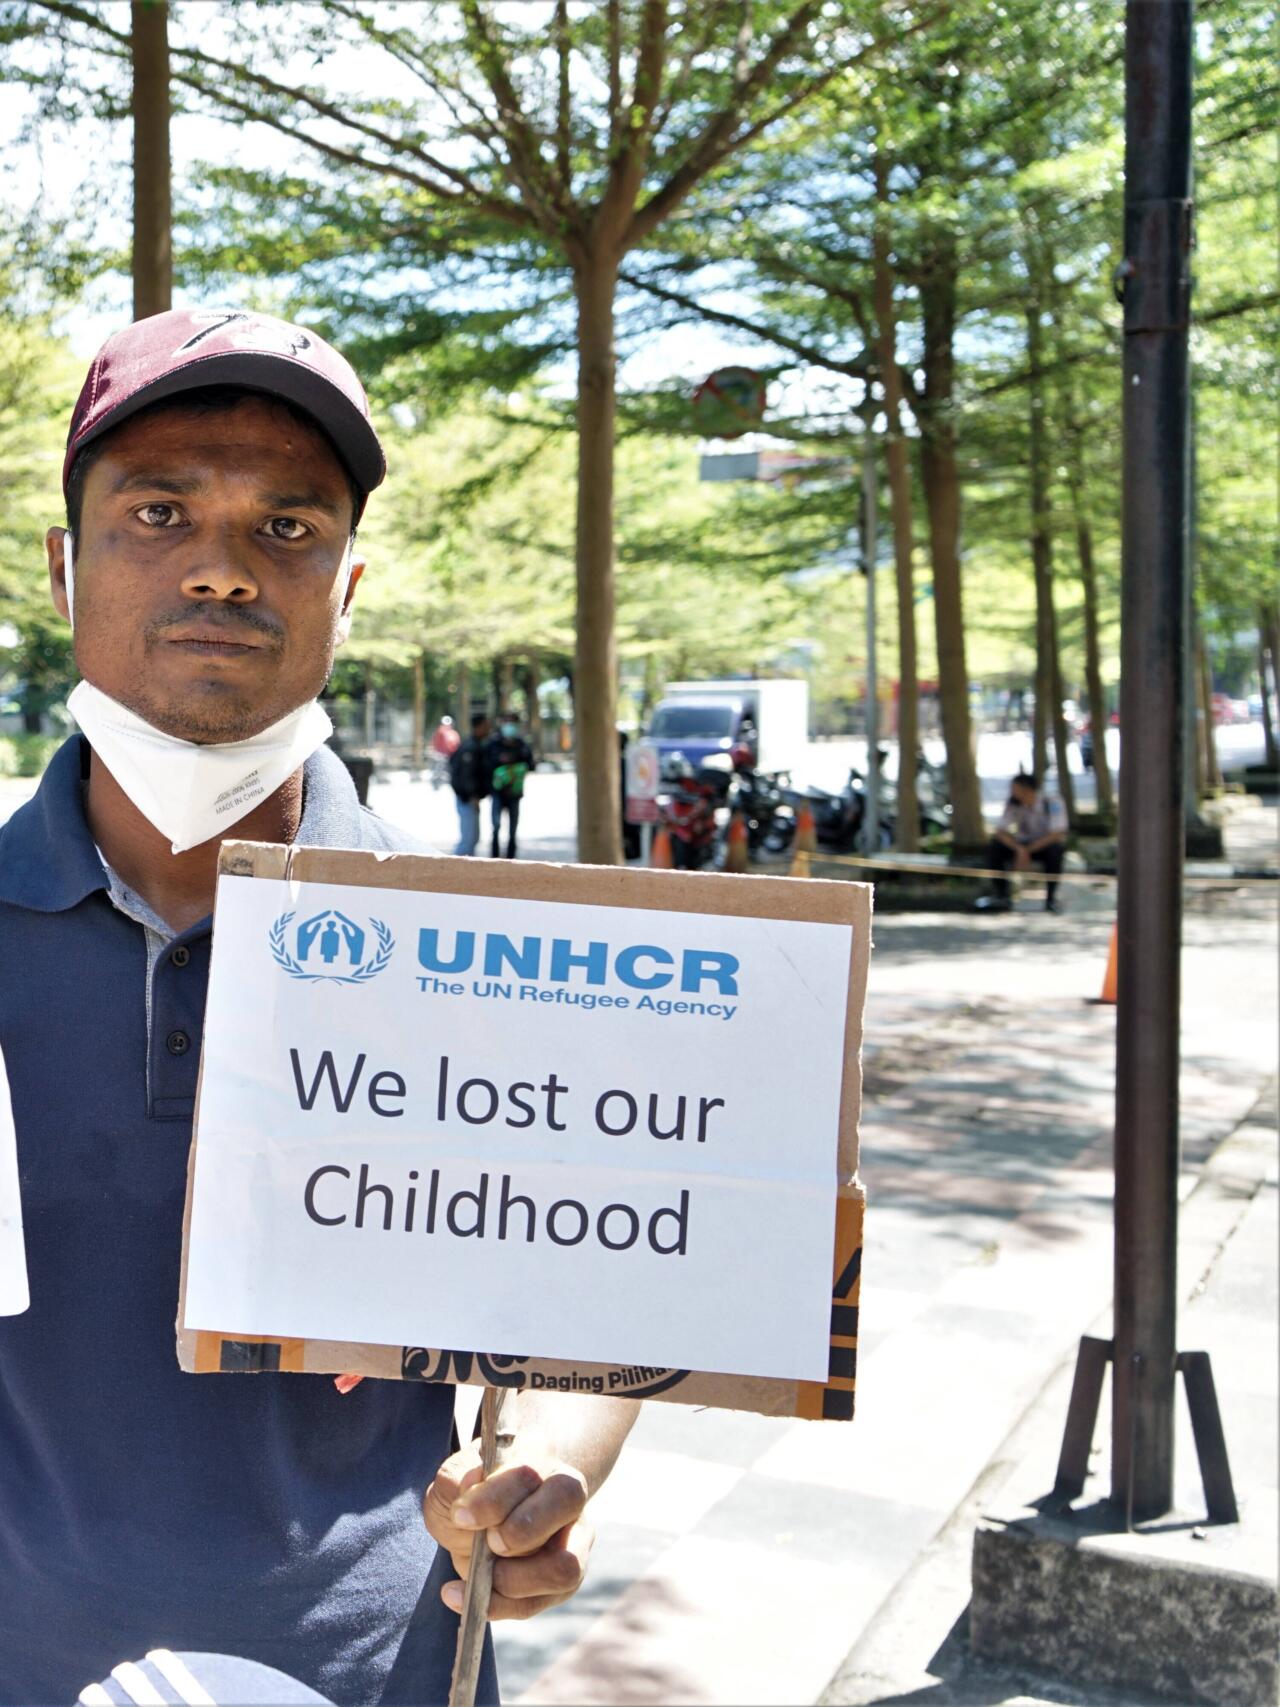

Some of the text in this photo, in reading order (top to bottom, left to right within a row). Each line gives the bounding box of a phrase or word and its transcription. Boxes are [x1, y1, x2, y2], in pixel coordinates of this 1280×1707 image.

[243, 786, 265, 801] CHINA
[417, 927, 741, 996] UNHCR
[415, 976, 737, 1021] The UN Refugee Agency
[289, 1047, 726, 1143] We lost our
[303, 1162, 690, 1256] Childhood
[530, 1366, 672, 1394] Daging Piliha
